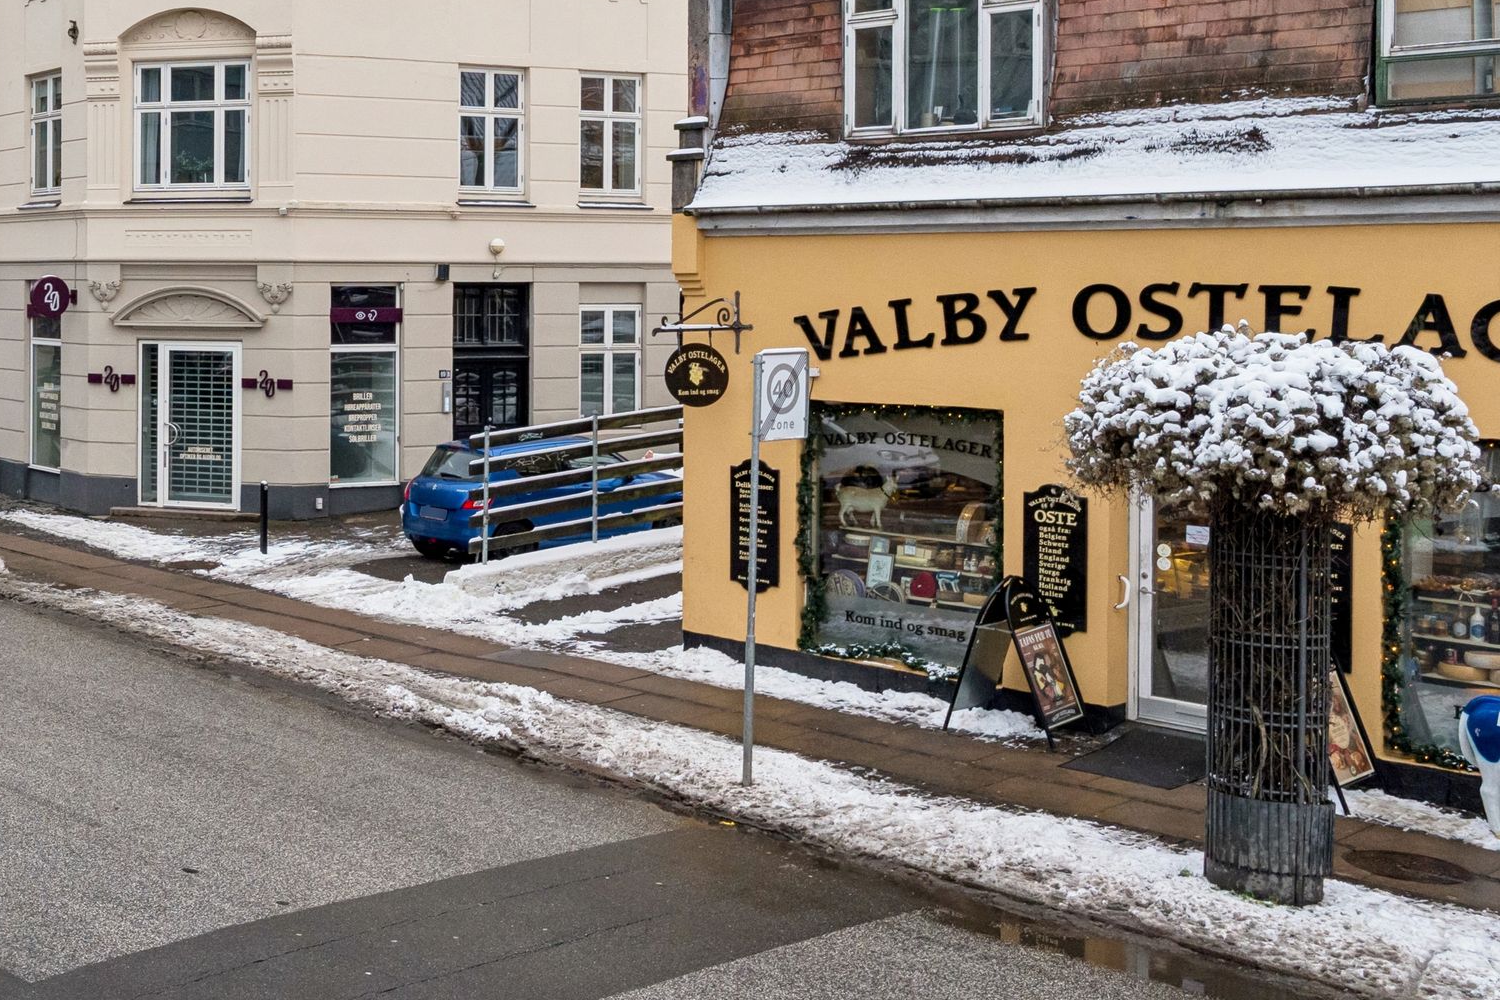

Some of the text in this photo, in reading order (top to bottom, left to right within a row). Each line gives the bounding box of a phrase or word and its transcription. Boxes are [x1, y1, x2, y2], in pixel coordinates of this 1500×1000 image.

[793, 286, 1038, 361] VALBY
[668, 350, 726, 374] VALBY OSTELAGER
[353, 392, 372, 400] BRILLER
[771, 419, 795, 431] Zone
[823, 431, 993, 459] VALBY OSTELAGER
[1034, 509, 1078, 526] OSTE
[1038, 532, 1067, 541] Belgien
[1038, 546, 1062, 554] Irland
[1038, 553, 1070, 564] England
[1038, 560, 1066, 570] Sverige
[1038, 568, 1060, 577] Norge
[1038, 574, 1072, 586] Frankrig
[1038, 582, 1068, 592] Holland
[845, 610, 966, 642] Kom ind og smag
